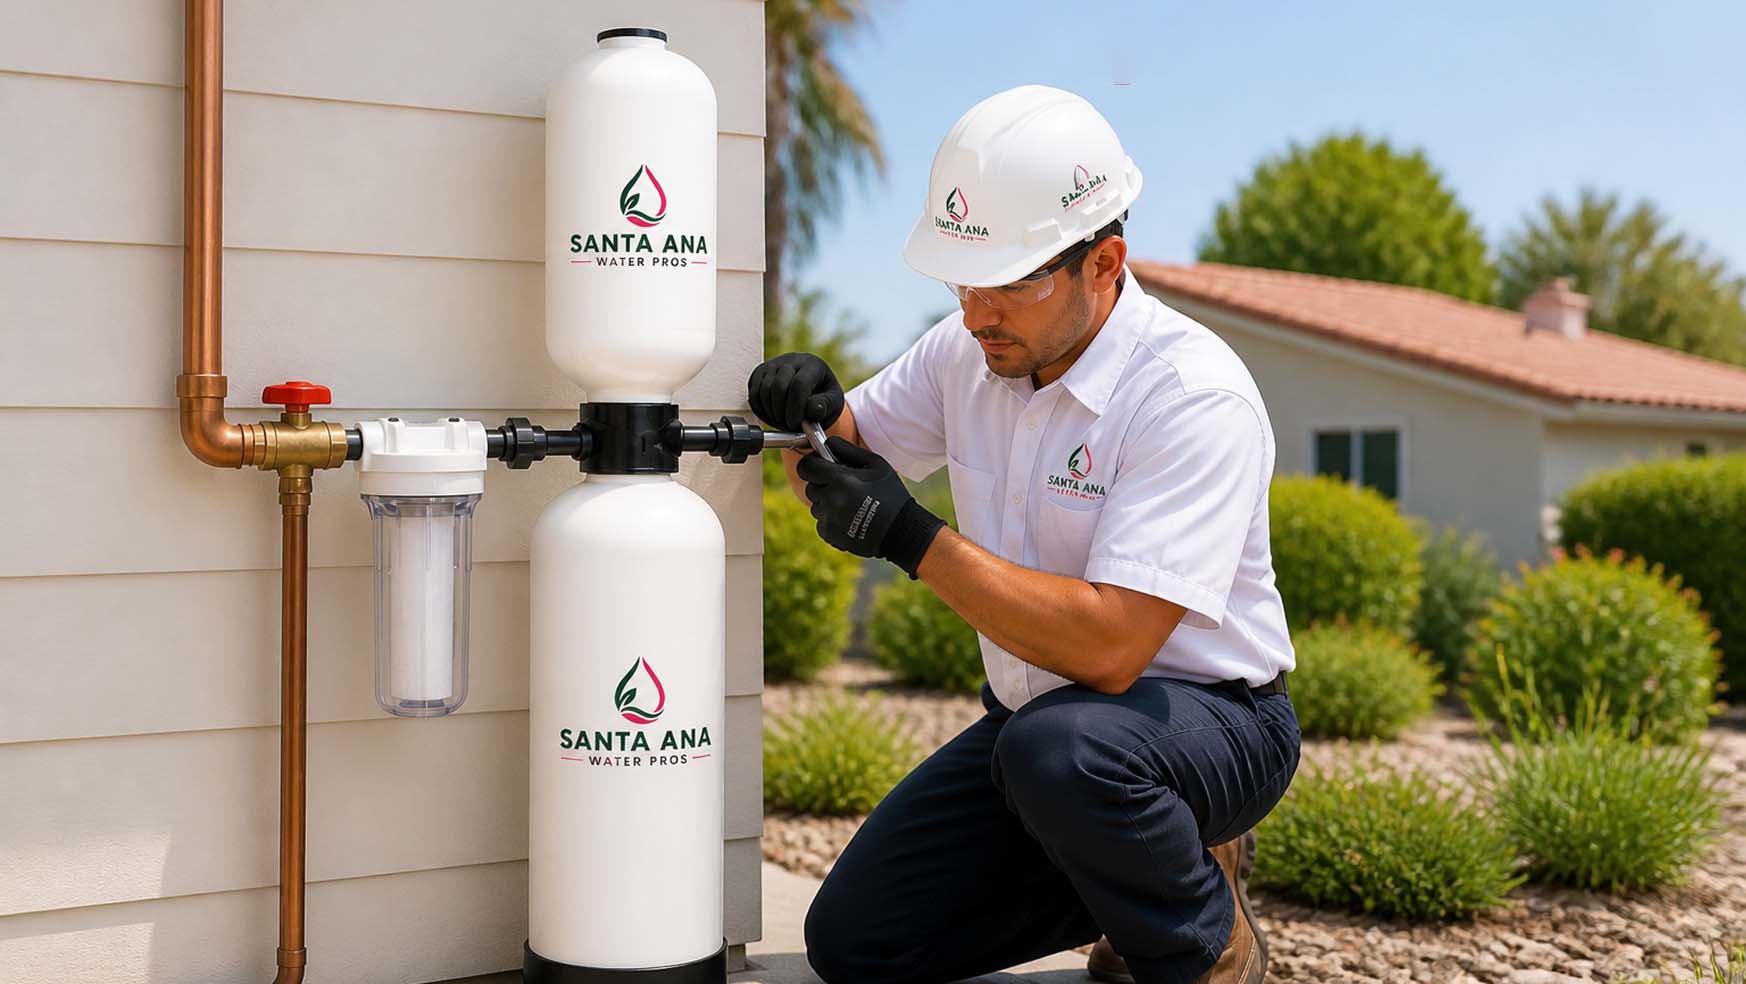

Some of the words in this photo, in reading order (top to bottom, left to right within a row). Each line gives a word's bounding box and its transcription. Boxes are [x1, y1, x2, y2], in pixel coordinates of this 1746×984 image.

[965, 224, 989, 237] ANA
[570, 234, 653, 254] SANTA
[662, 234, 708, 255] ANA
[596, 257, 645, 267] WATER
[652, 257, 688, 268] PROS
[1082, 482, 1106, 497] ANA
[560, 728, 650, 752] SANTA
[660, 726, 712, 751] ANA
[589, 755, 641, 767] WATER
[650, 754, 688, 767] PROS
